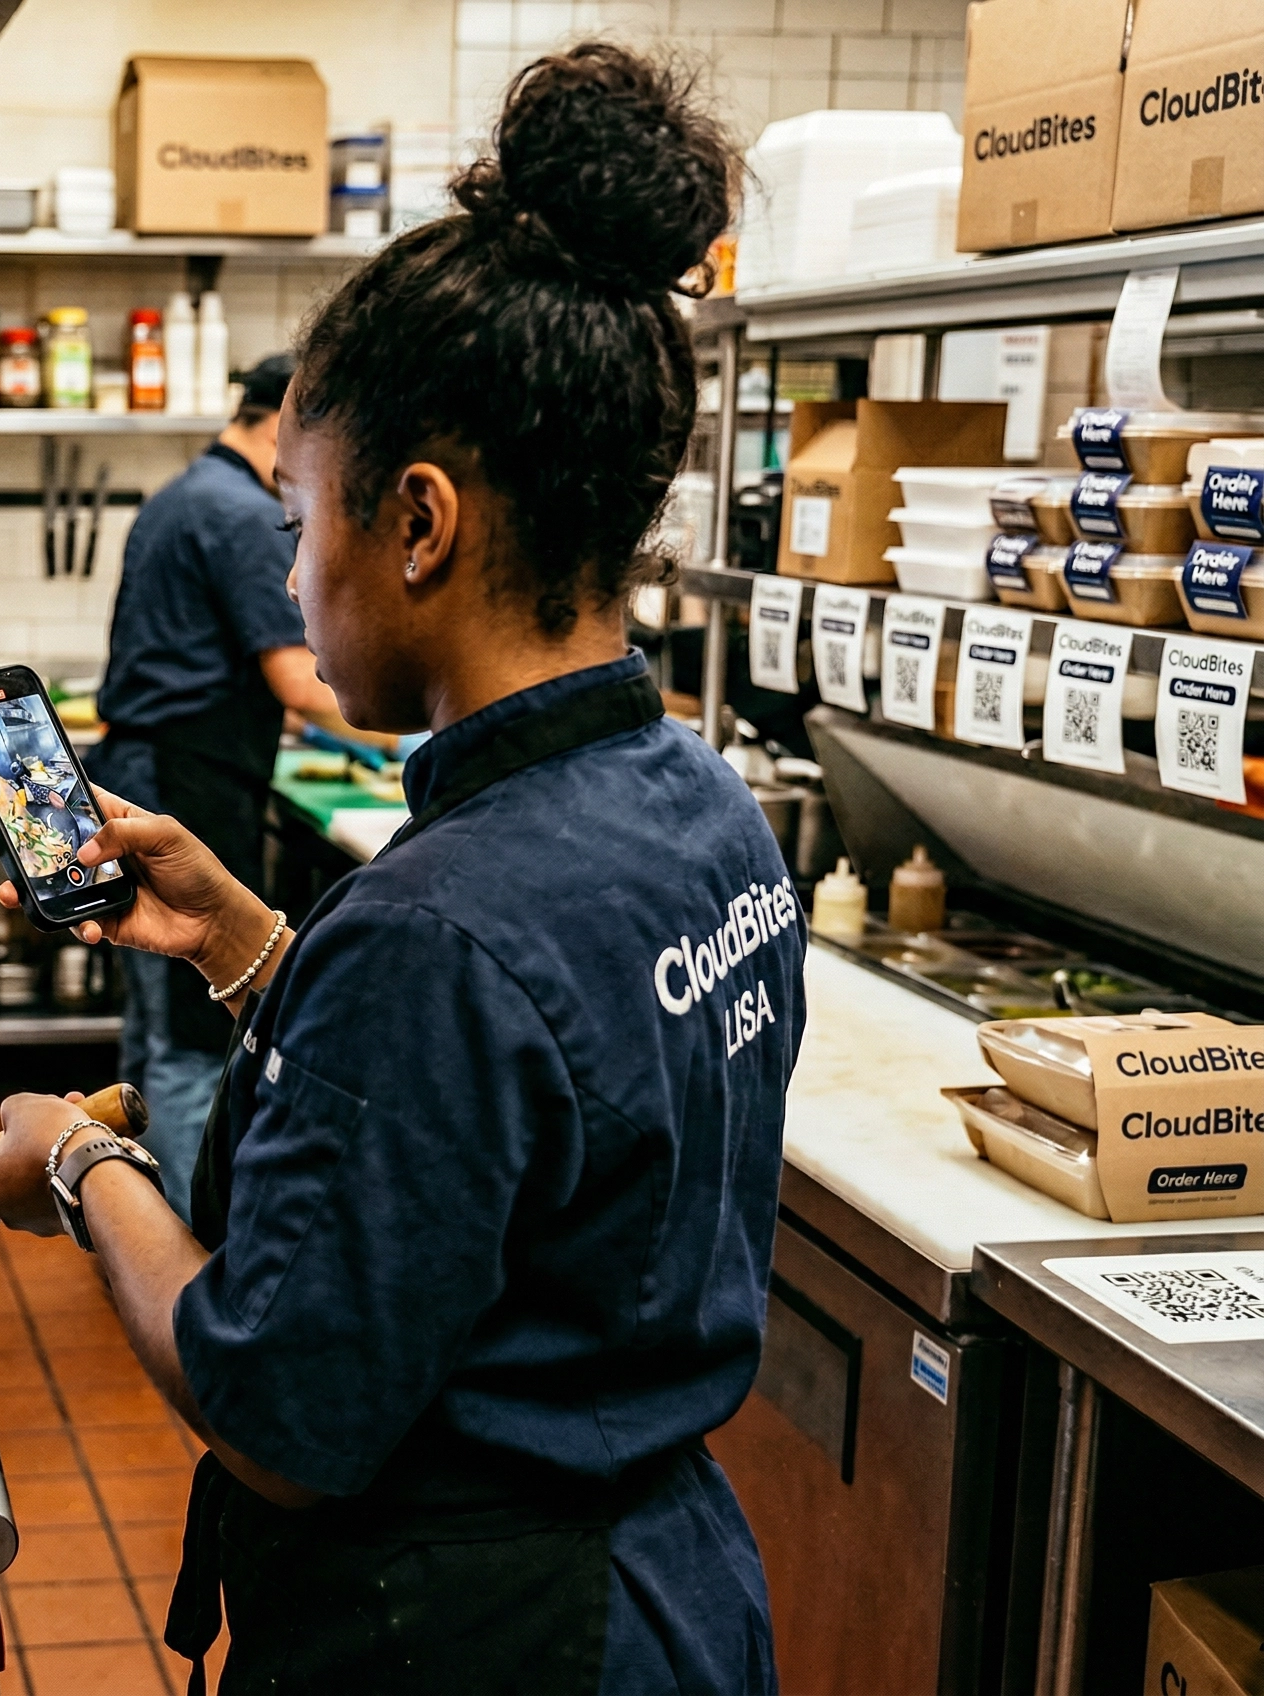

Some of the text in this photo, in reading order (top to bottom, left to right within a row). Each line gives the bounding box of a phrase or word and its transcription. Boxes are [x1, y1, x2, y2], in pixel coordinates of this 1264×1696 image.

[1140, 68, 1264, 126] CloudBit
[974, 114, 1096, 161] CloudBites
[1168, 649, 1244, 676] CloudBites
[1174, 679, 1205, 697] Order
[654, 876, 797, 1016] CloudBites
[1116, 1045, 1264, 1077] CloudBite
[1157, 1171, 1238, 1188] Order Here
